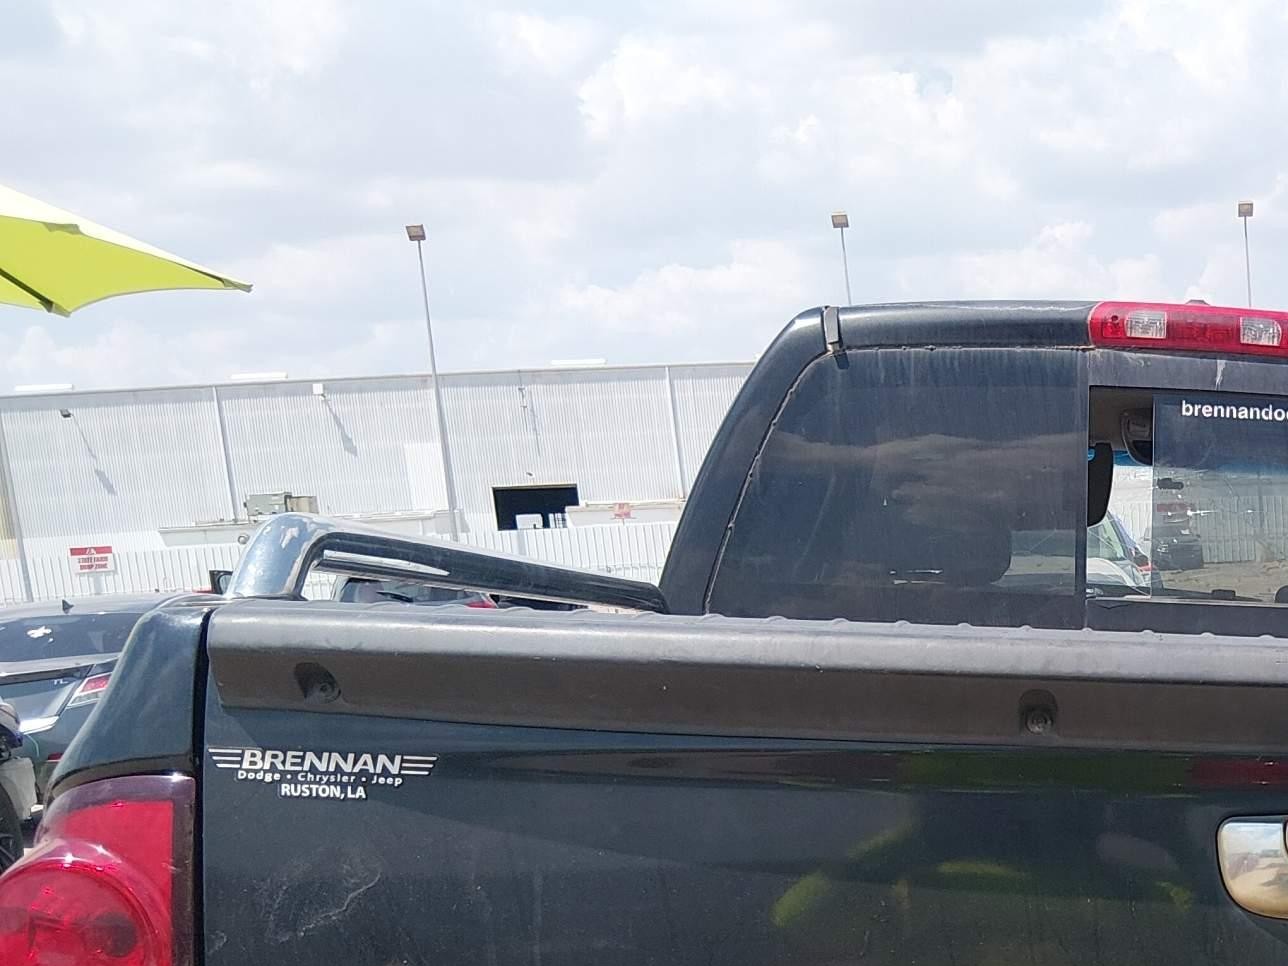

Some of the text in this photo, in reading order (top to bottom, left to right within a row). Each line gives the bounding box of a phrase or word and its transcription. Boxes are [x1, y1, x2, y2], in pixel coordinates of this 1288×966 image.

[241, 749, 402, 775] BRENNAN
[237, 769, 403, 787] Dodge Chrysler Jeep
[280, 783, 366, 800] RUSTON, LA
